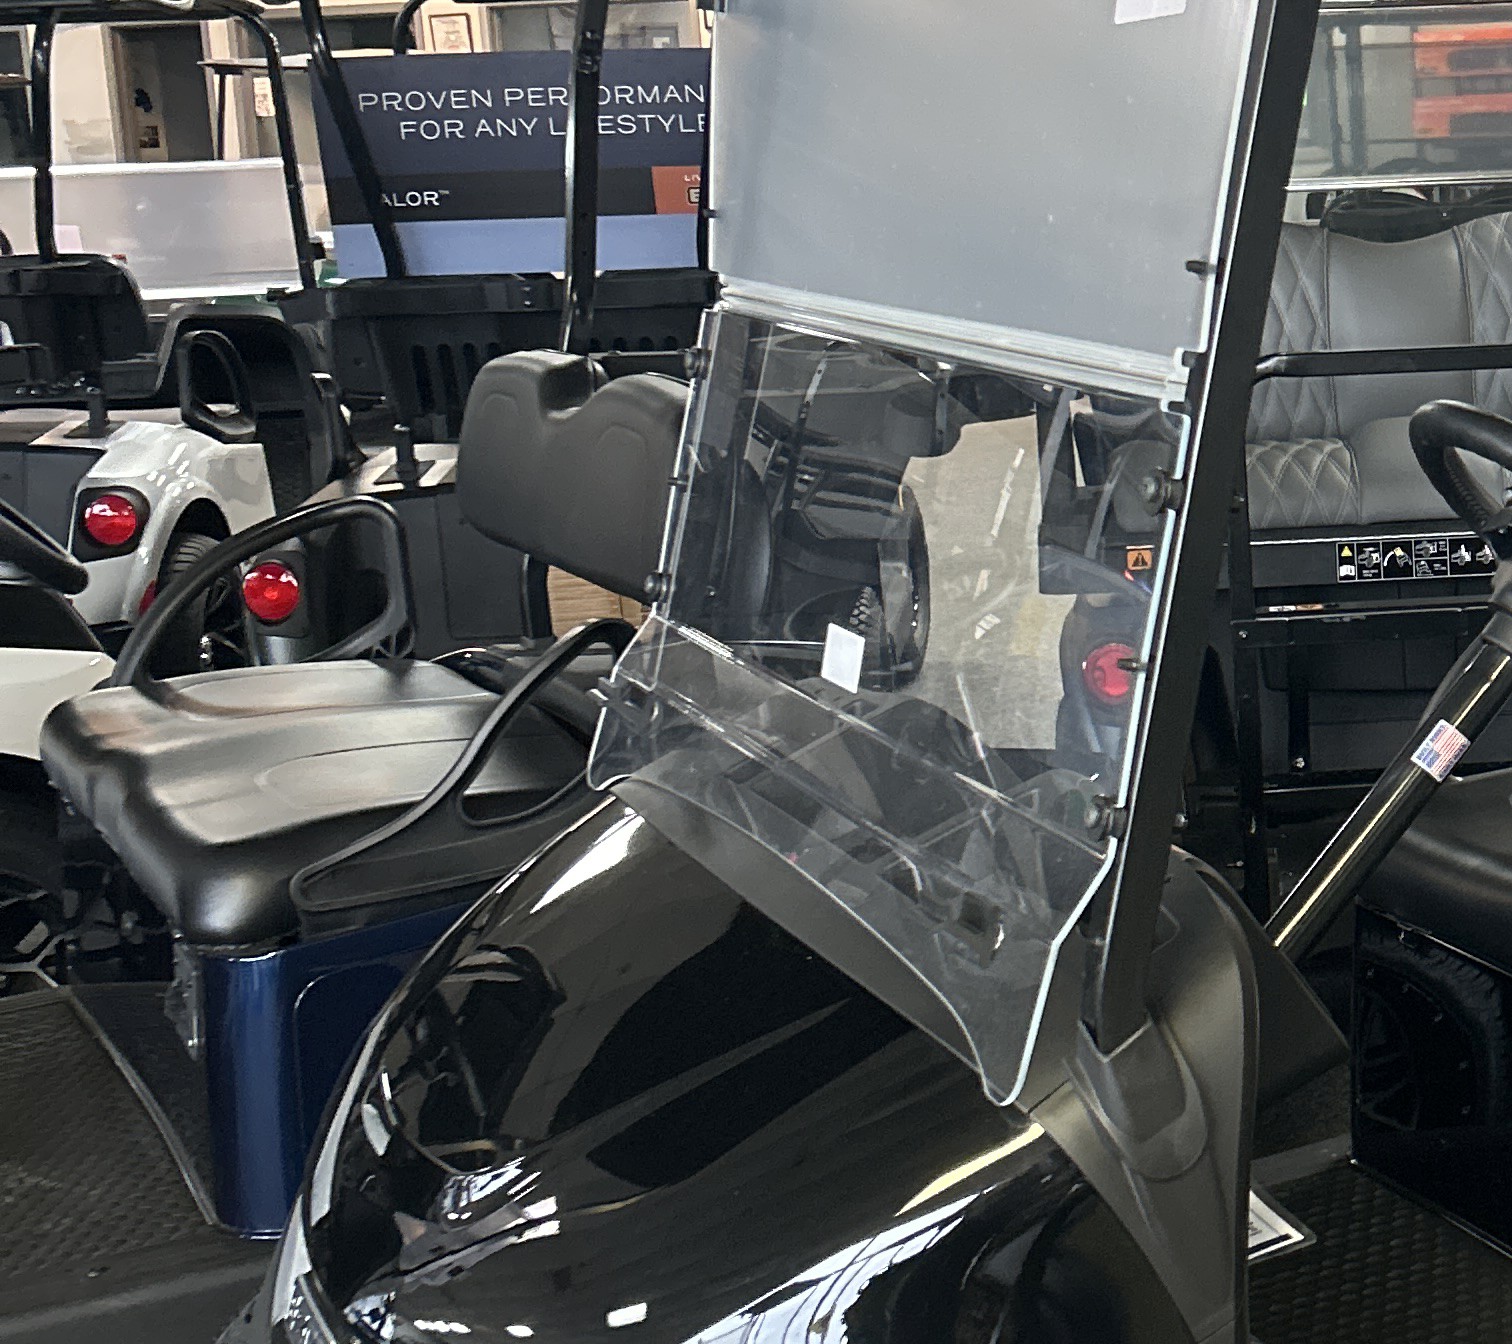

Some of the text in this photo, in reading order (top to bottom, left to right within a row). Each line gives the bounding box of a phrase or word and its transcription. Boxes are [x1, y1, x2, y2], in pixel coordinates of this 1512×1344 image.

[358, 84, 705, 113] PROVEN PERORMAN
[400, 112, 706, 140] FOR ANY LESTYL
